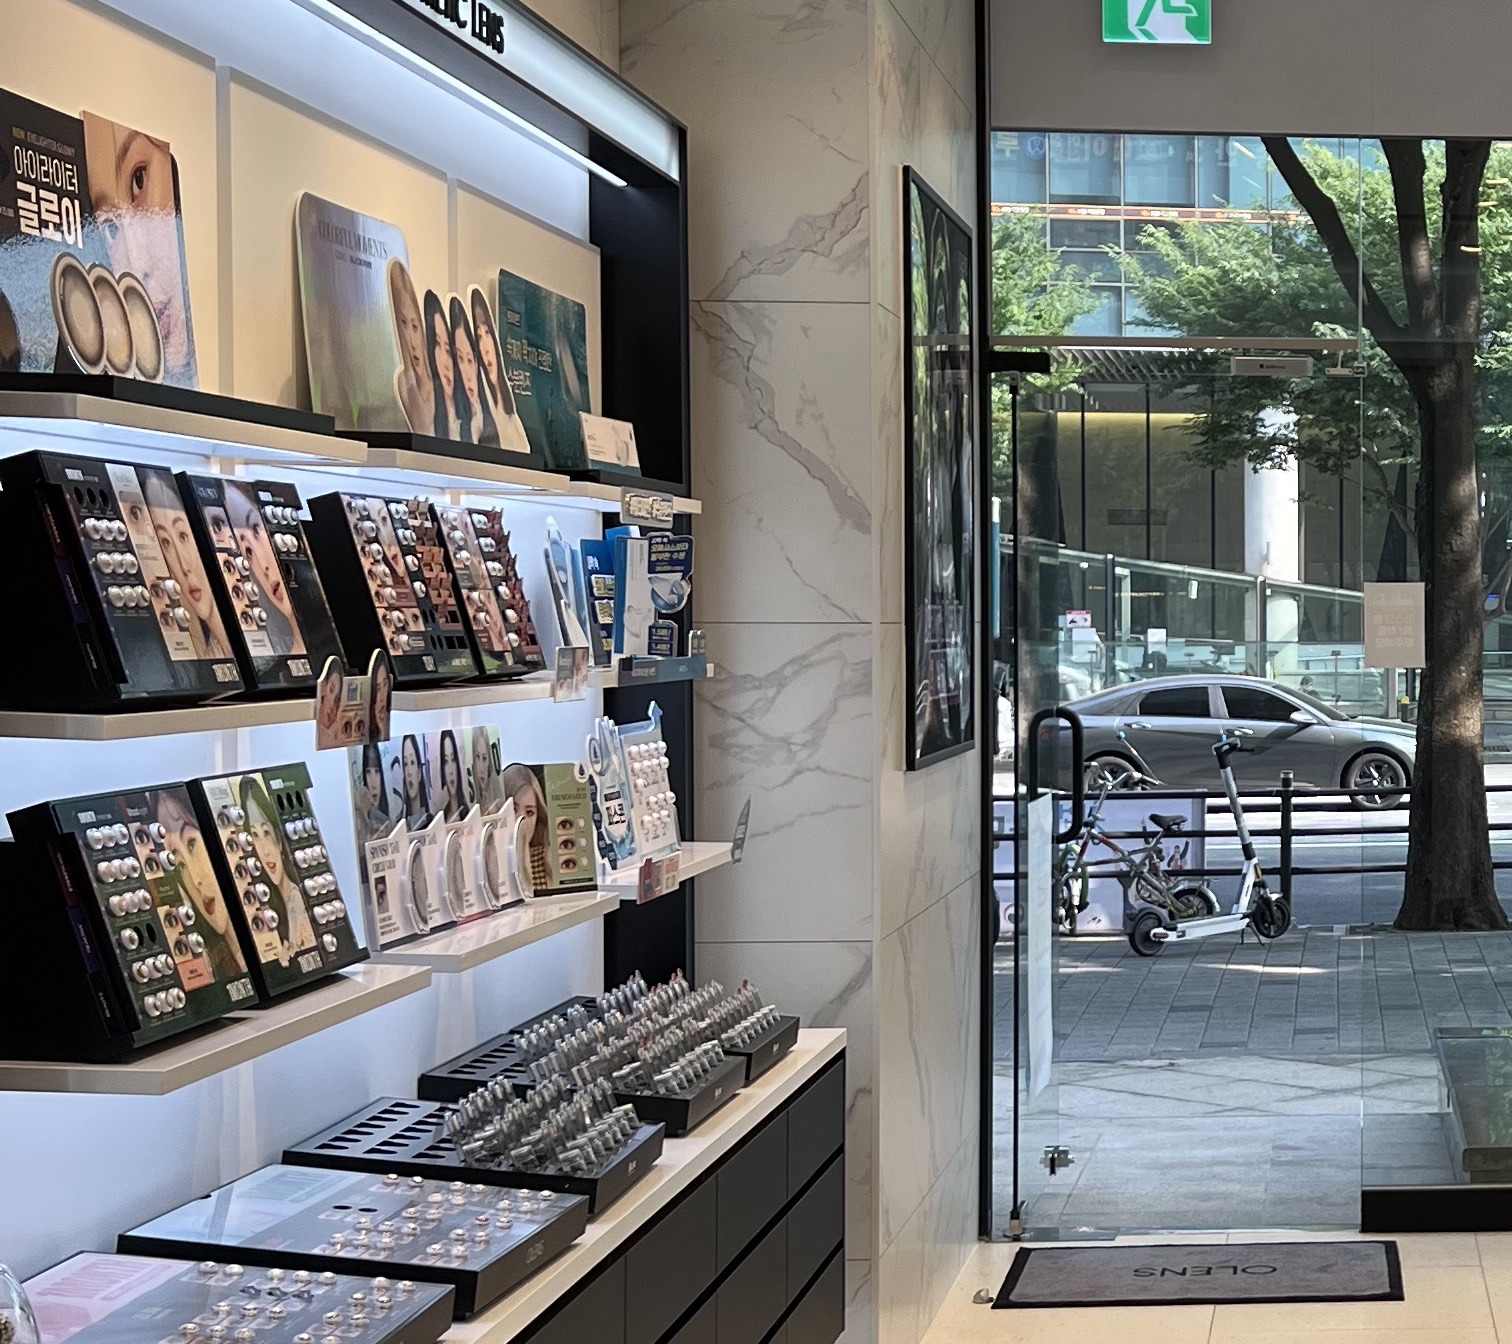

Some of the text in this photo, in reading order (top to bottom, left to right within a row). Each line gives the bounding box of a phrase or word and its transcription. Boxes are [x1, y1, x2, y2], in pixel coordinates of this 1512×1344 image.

[13, 145, 79, 194] 아이라이터
[16, 181, 83, 249] 글로이
[1133, 1265, 1277, 1277] OLENS
